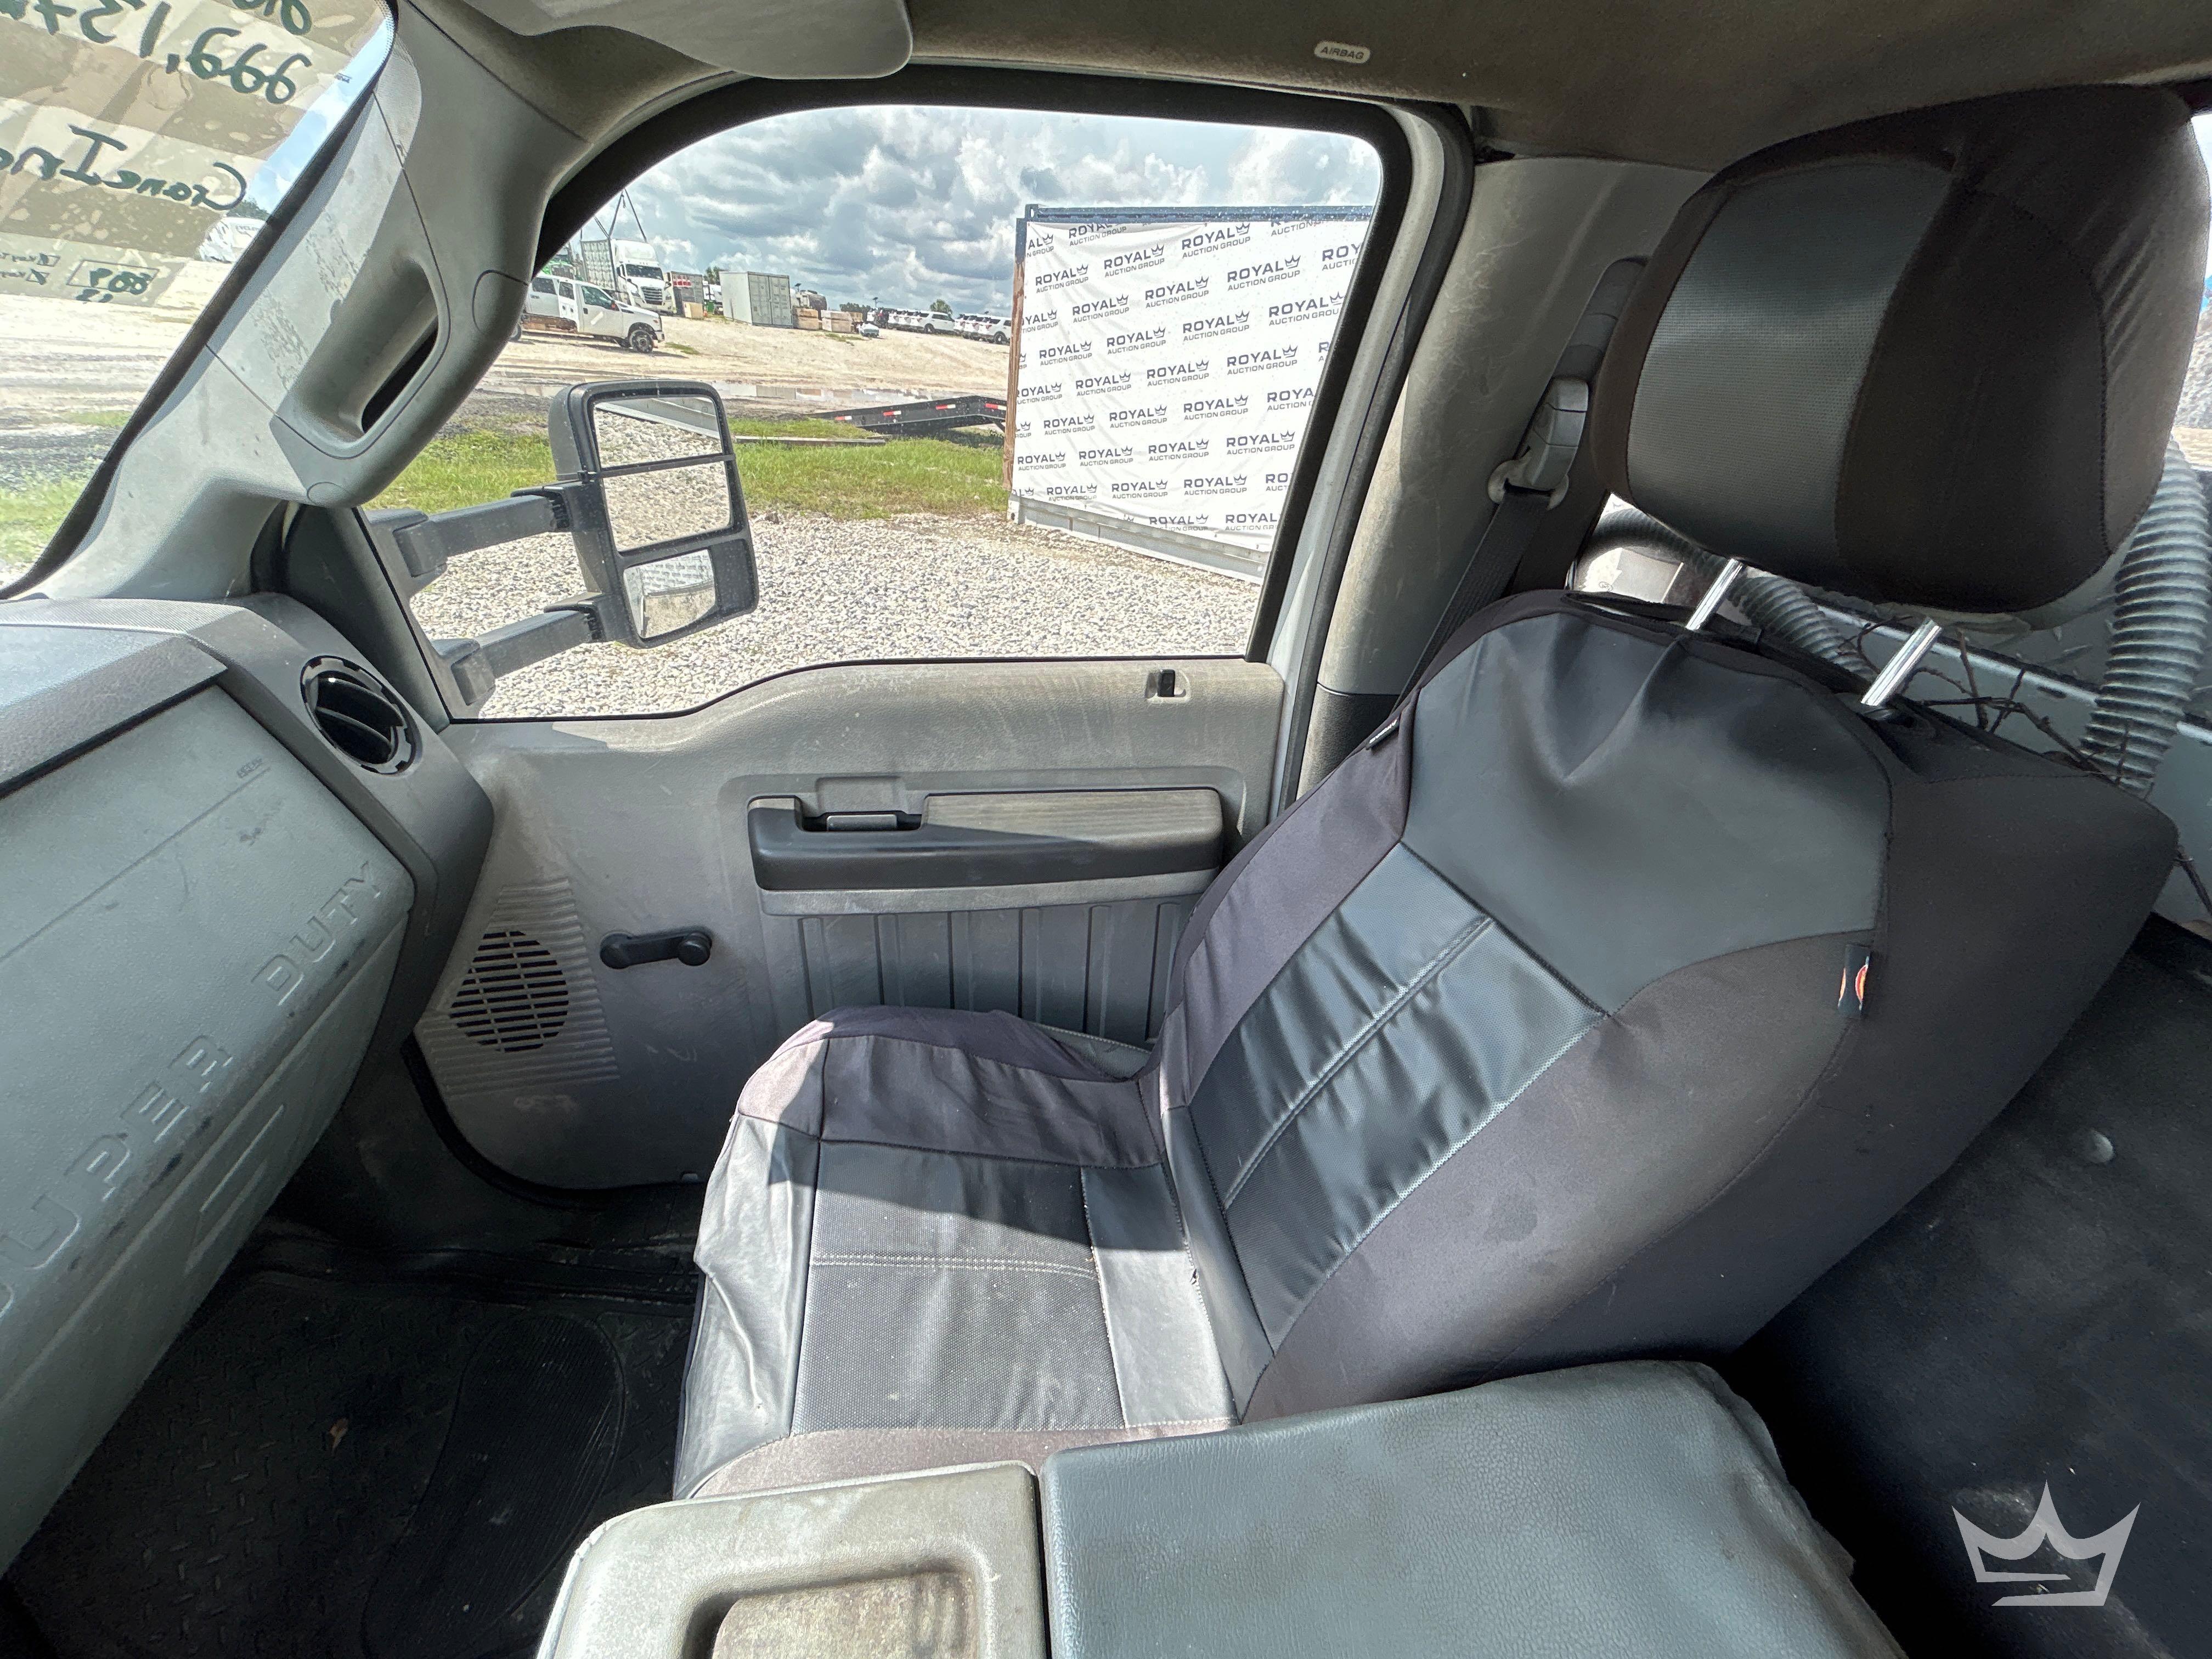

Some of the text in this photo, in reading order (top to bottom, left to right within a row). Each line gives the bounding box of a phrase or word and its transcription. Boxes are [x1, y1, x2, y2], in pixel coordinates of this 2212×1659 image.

[1069, 227, 1126, 246] AUCTION GROUP
[1182, 228, 1235, 250] ROYAL
[1032, 246, 1054, 256] GROUP
[1182, 236, 1250, 258] AUCTION GROUP
[1104, 250, 1151, 269] ROYAL
[1104, 258, 1165, 278] AUCTION GROUP
[1227, 261, 1284, 283] ROYAL
[1036, 268, 1076, 286] ROYAL
[1228, 270, 1300, 291] AUCTION GROUP
[1036, 277, 1088, 293] AUCTION GROUP
[1146, 281, 1194, 300] ROYAL
[1073, 298, 1116, 315] ROYAL
[1146, 290, 1209, 308] AUCTION GROUP
[1269, 297, 1329, 317] ROYAL
[1073, 307, 1129, 323] AUCTION GROUP
[1269, 308, 1339, 326] AUCTION GROU
[1037, 321, 1058, 330] GROUP
[1183, 315, 1234, 334] ROYAL
[1107, 331, 1153, 347] ROYAL
[1183, 325, 1250, 342] AUCTION GROUP
[1039, 344, 1080, 359] ROYAL
[1108, 340, 1166, 354] AUCTION GROUP
[1040, 353, 1092, 366] AUCTION GROUP
[1227, 350, 1281, 367] ROYAL
[1147, 364, 1195, 379] ROYAL
[1227, 360, 1297, 375] AUCTION GROUP
[1076, 375, 1119, 389] ROYAL
[1147, 373, 1209, 386] AUCTION GROUP
[1076, 384, 1131, 396] AUCTION GROUP
[1041, 394, 1062, 402] GROUP
[1183, 398, 1234, 413] ROYAL
[1220, 408, 1248, 416] GROUP
[1267, 402, 1306, 411] AUCTION
[1044, 416, 1083, 428] ROYAL
[1109, 408, 1154, 421] ROYAL
[1149, 442, 1195, 454] ROYAL
[1227, 434, 1279, 447] ROYAL
[1018, 454, 1054, 465] ROYAL
[1079, 448, 1121, 460] ROYAL
[1111, 482, 1155, 492] ROYAL
[1184, 477, 1233, 488] ROYAL
[1047, 486, 1086, 495] ROYAL
[1149, 516, 1194, 525] ROYAL
[1225, 514, 1277, 523] ROYAL
[251, 860, 382, 1007] DUTY
